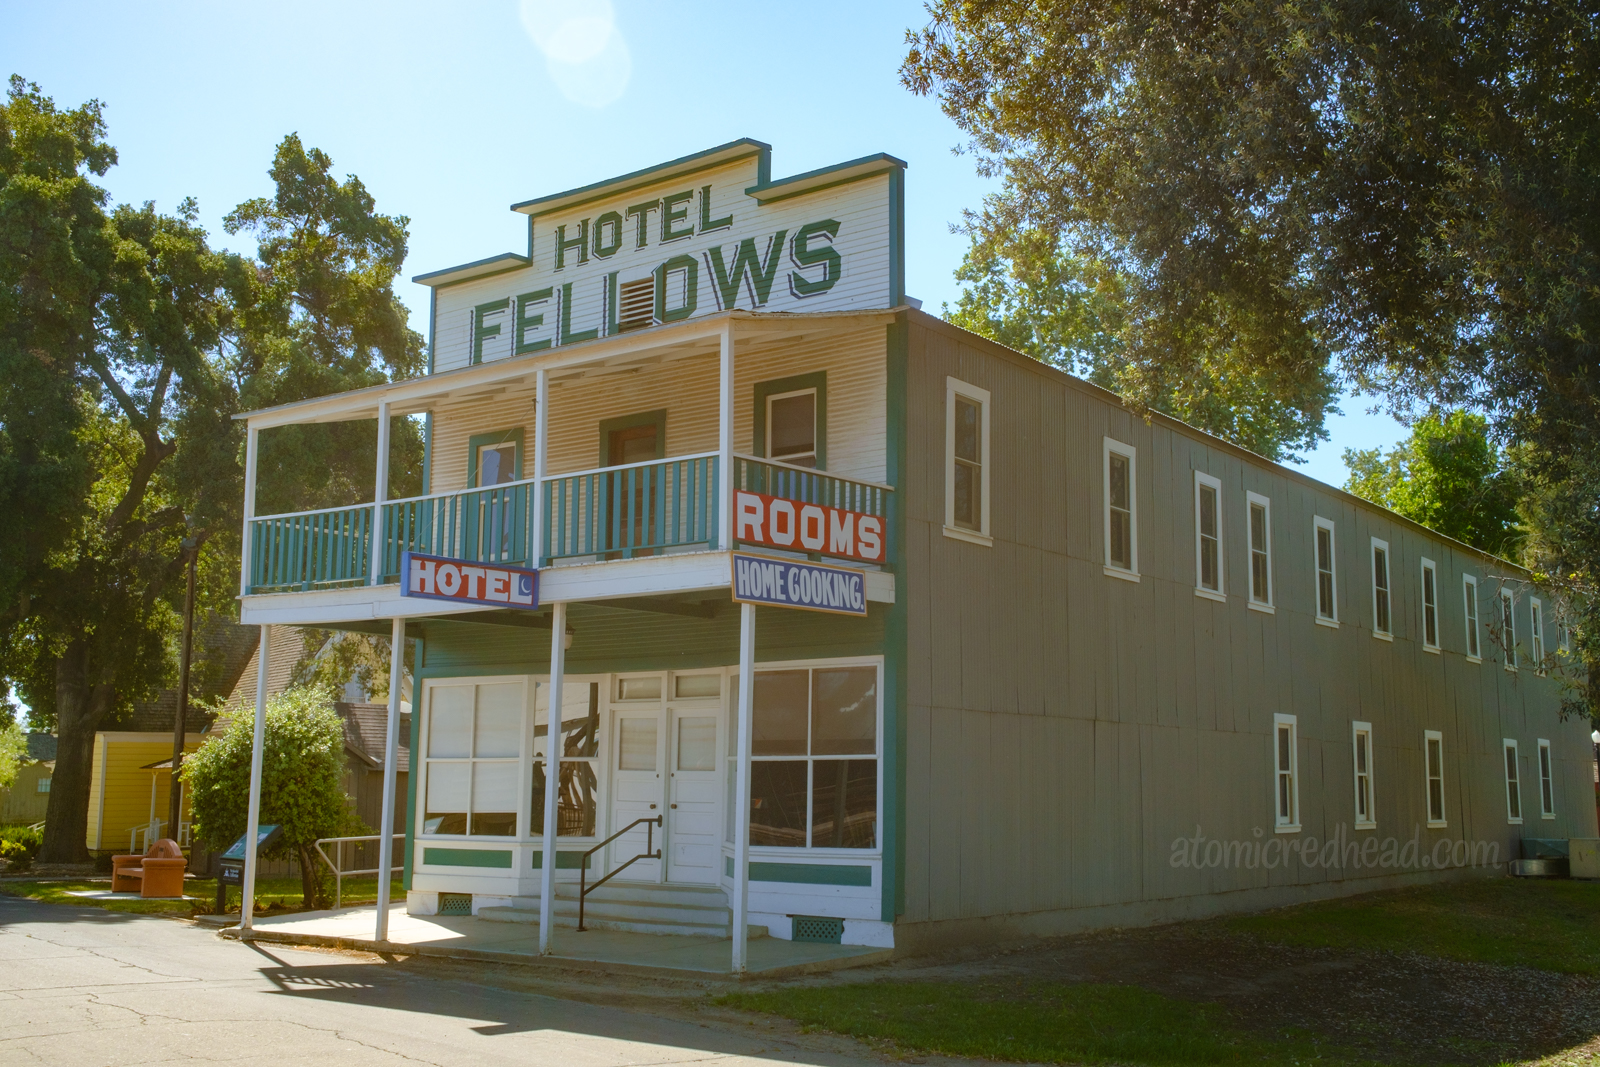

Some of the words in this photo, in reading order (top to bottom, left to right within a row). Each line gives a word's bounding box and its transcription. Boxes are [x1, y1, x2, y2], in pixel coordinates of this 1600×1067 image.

[553, 185, 733, 272] HOTEL
[737, 492, 881, 559] ROOMS
[410, 559, 532, 605] HOTEL
[737, 559, 786, 600] HOME
